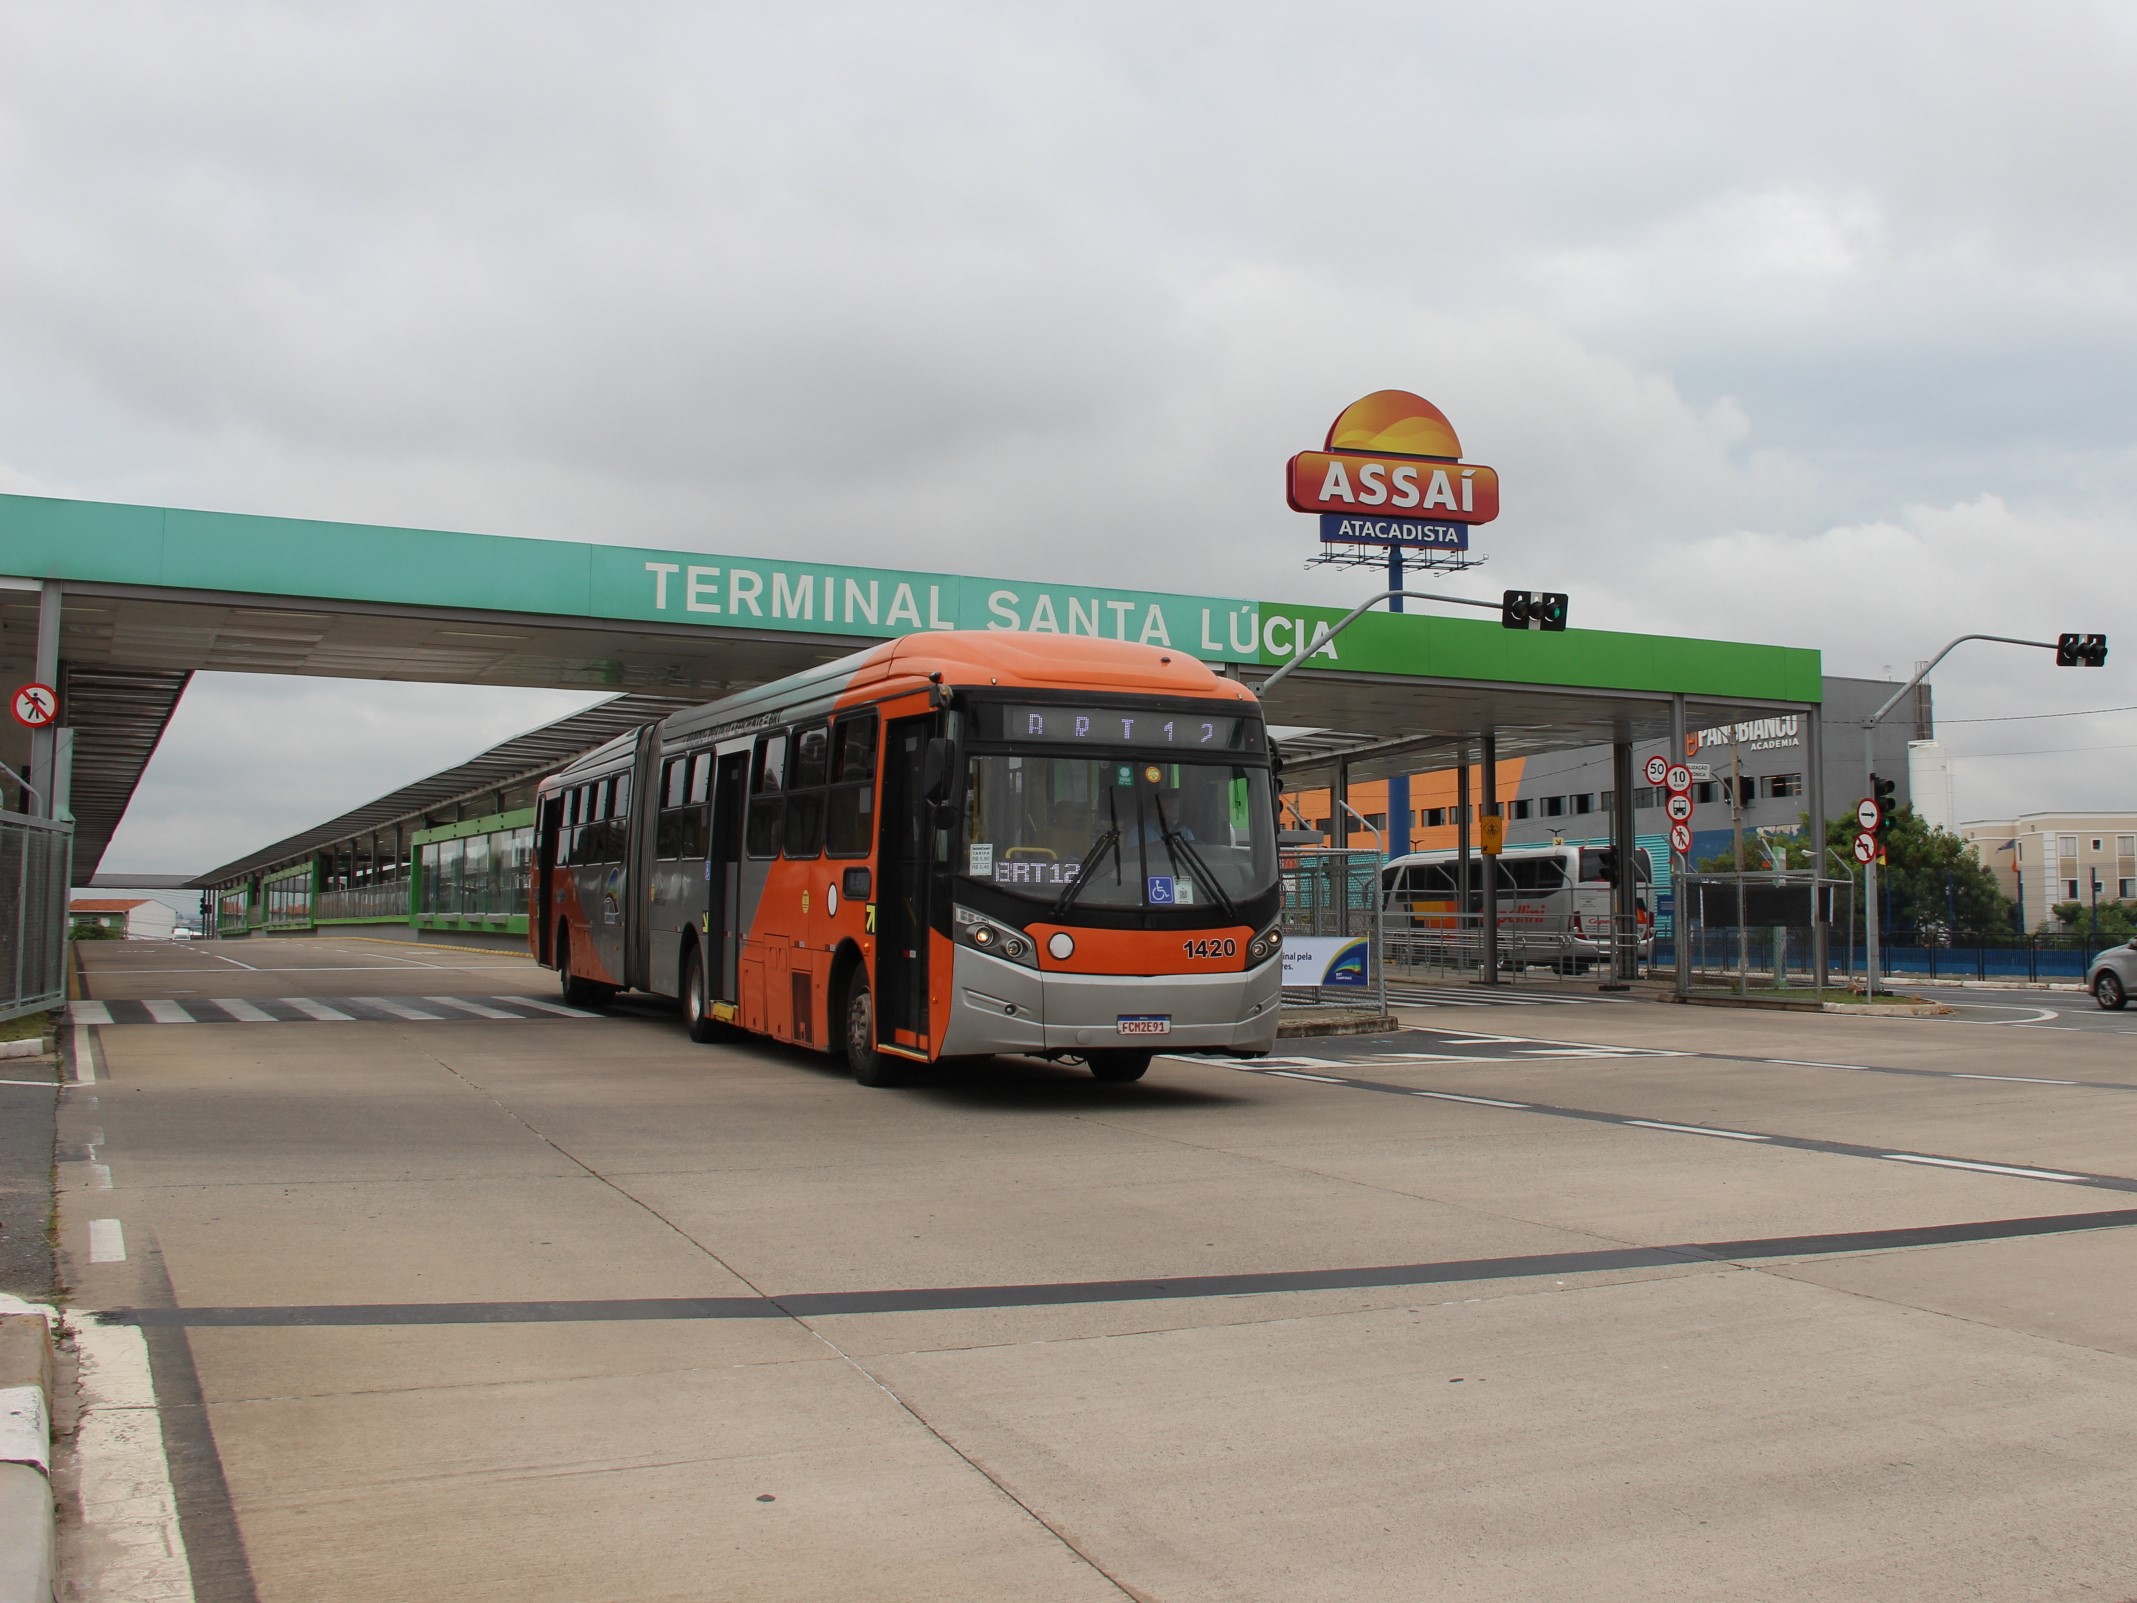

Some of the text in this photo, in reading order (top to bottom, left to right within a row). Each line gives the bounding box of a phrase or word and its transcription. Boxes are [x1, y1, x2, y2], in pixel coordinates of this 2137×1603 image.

[1338, 519, 1459, 543] ATACADISTA
[644, 561, 1339, 660] TERMINAL SANTA LÚCIA
[1698, 714, 1799, 749] PANBIANCO
[1750, 737, 1800, 752] ACADEMIA
[1650, 763, 1665, 775] 50
[1673, 770, 1686, 783] 10
[1183, 938, 1237, 959] 1420
[1297, 952, 1312, 962] pela
[1122, 1021, 1165, 1033] FCM2E91
